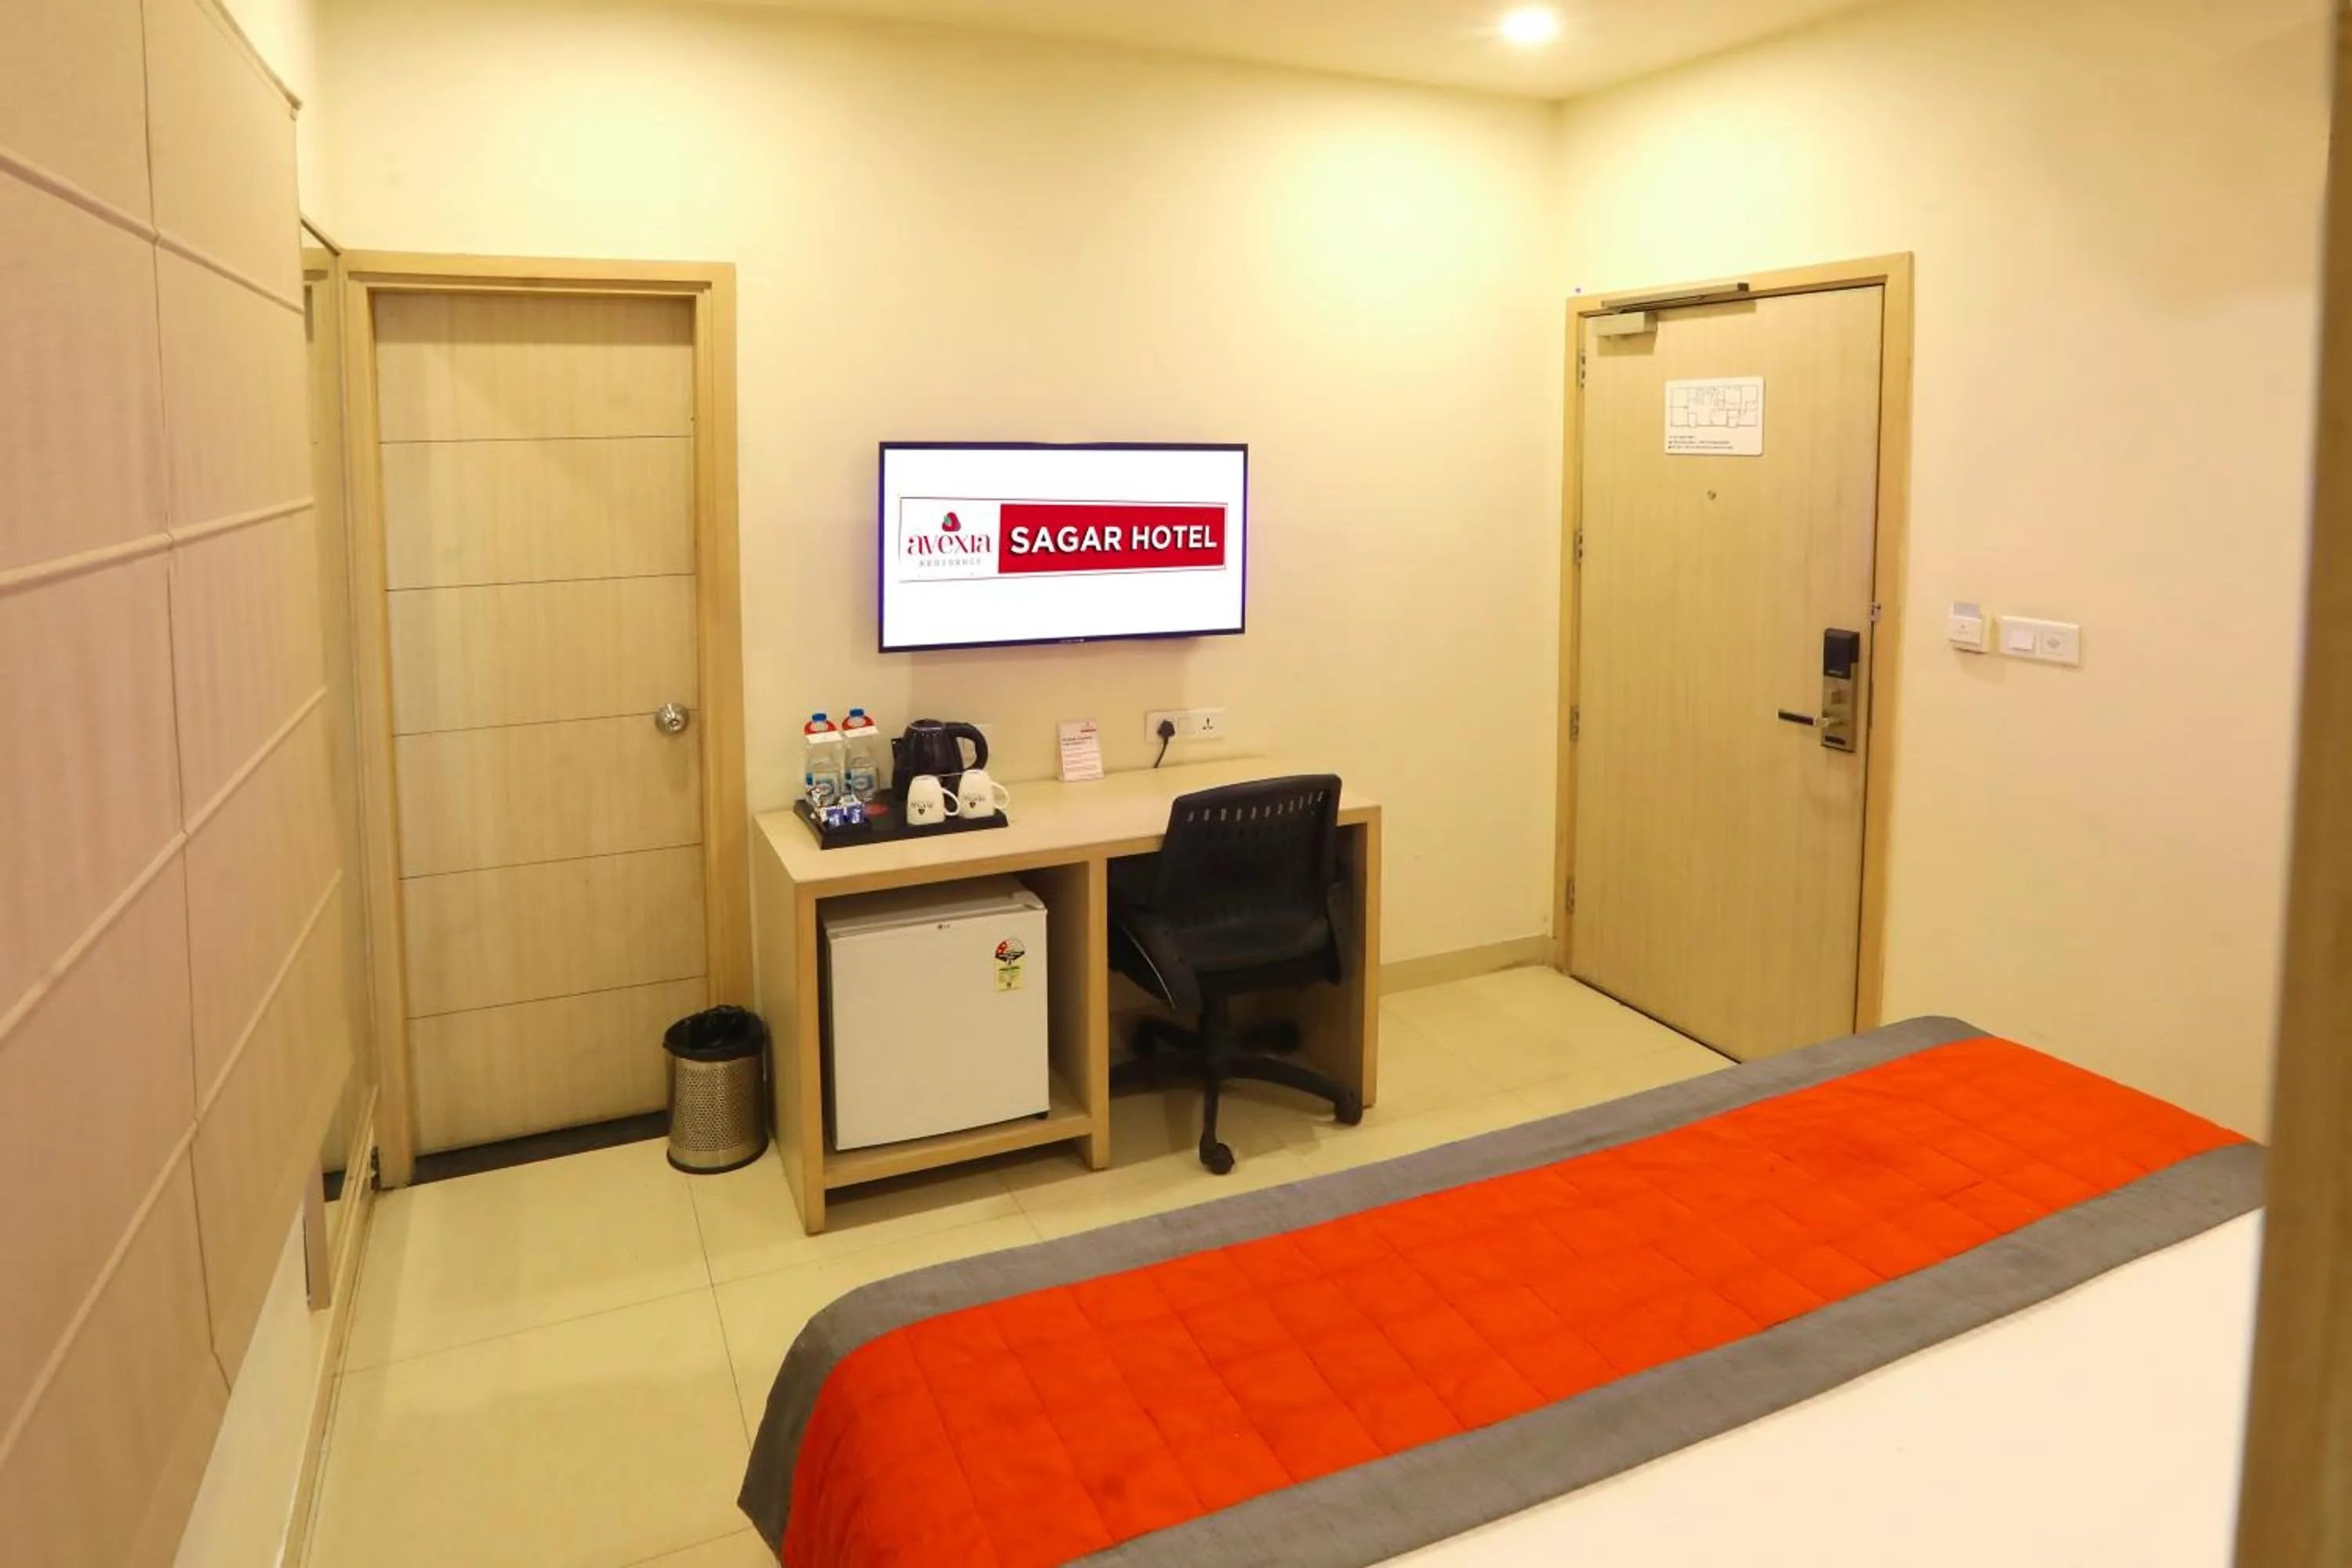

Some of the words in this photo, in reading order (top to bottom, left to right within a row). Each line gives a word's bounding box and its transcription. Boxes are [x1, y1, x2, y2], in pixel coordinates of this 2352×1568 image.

[908, 534, 992, 555] avexia
[1011, 526, 1122, 554] SAGAR
[1132, 525, 1217, 550] HOTEL
